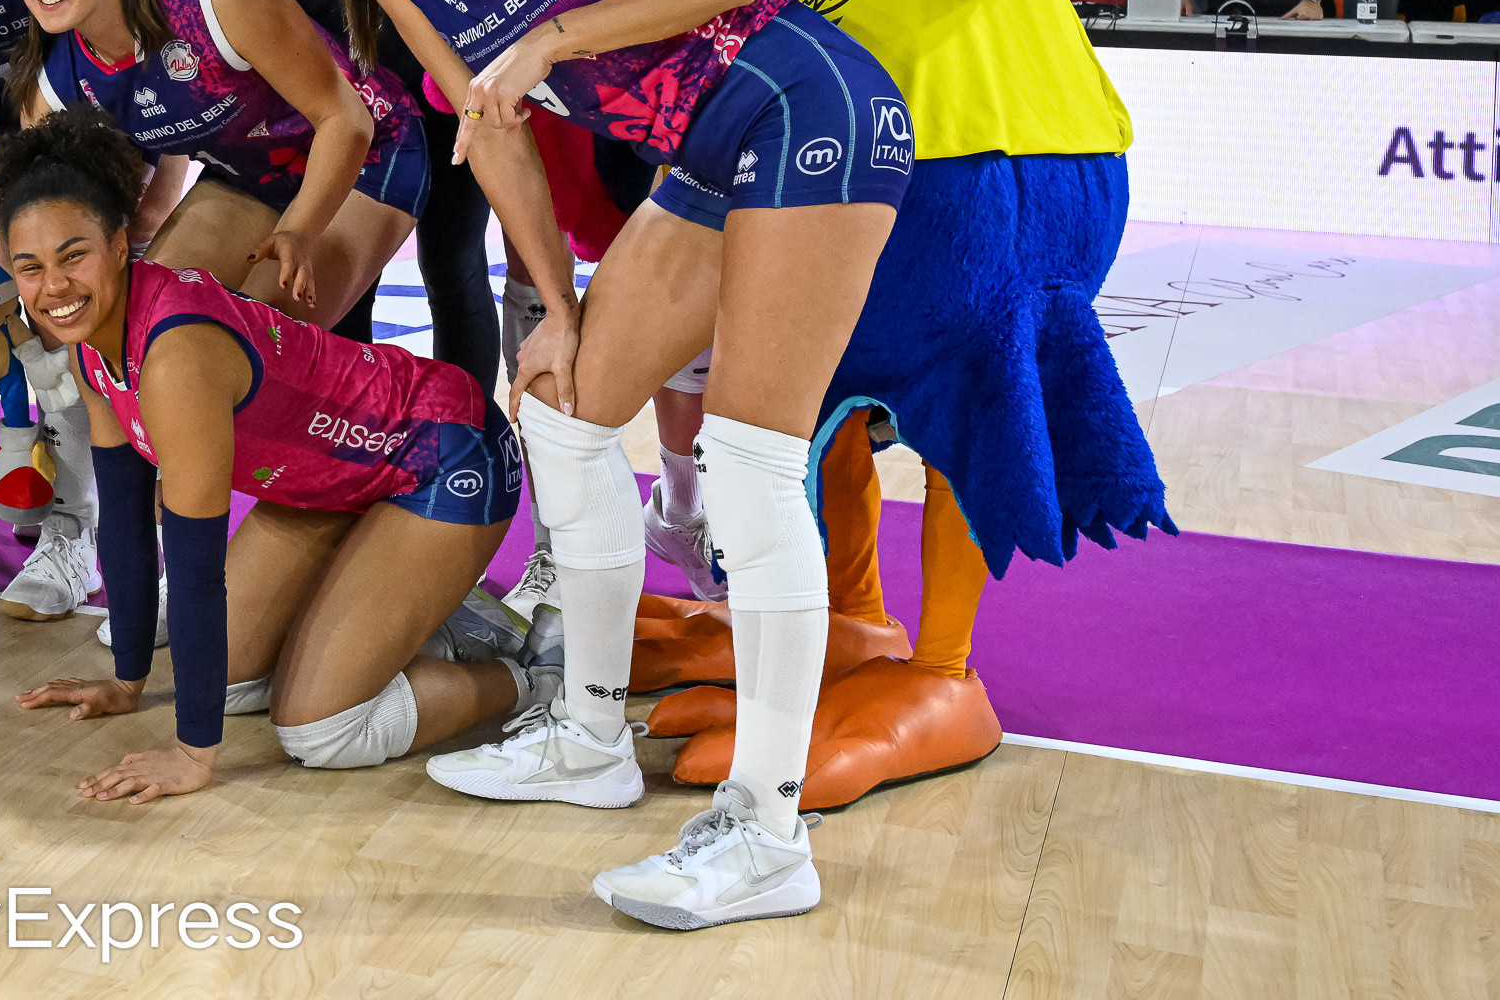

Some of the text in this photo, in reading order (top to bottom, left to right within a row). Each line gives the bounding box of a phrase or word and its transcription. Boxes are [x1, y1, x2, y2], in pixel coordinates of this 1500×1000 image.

[11, 17, 31, 31] DE
[497, 19, 528, 46] Forwarding
[134, 93, 238, 142] SAVINO DEL BENE
[141, 104, 167, 118] errea
[876, 145, 912, 166] ITALY
